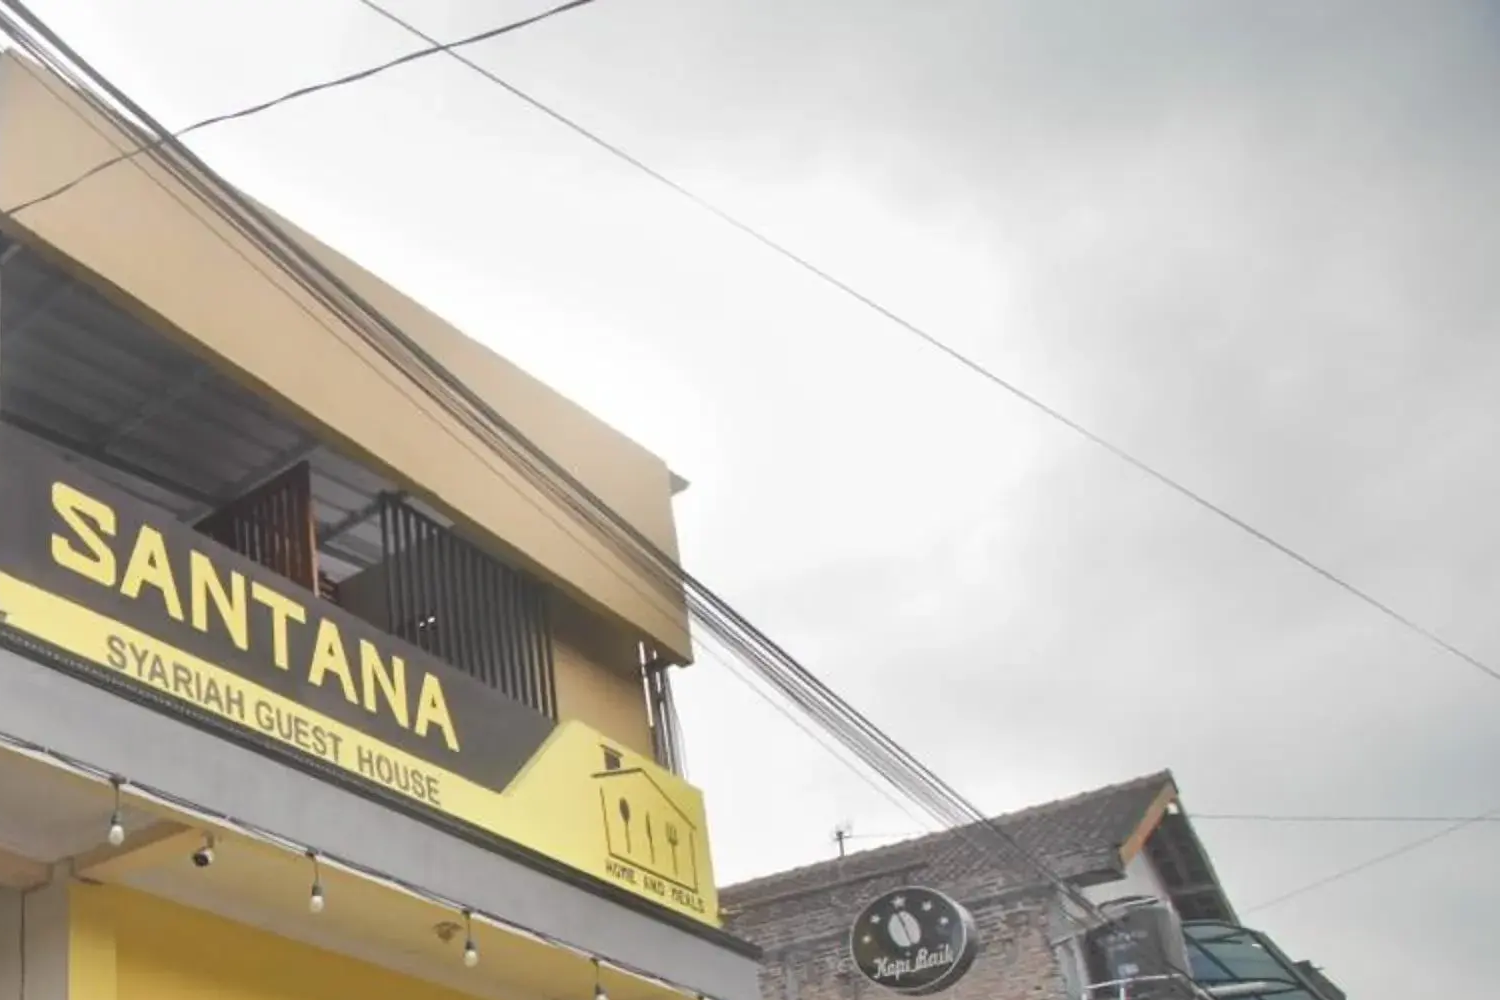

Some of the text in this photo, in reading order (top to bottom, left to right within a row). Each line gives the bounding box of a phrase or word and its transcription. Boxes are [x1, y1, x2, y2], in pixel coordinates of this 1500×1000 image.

[51, 481, 460, 752] SANTANA
[106, 634, 442, 807] SYARIAH GUEST HOUSE
